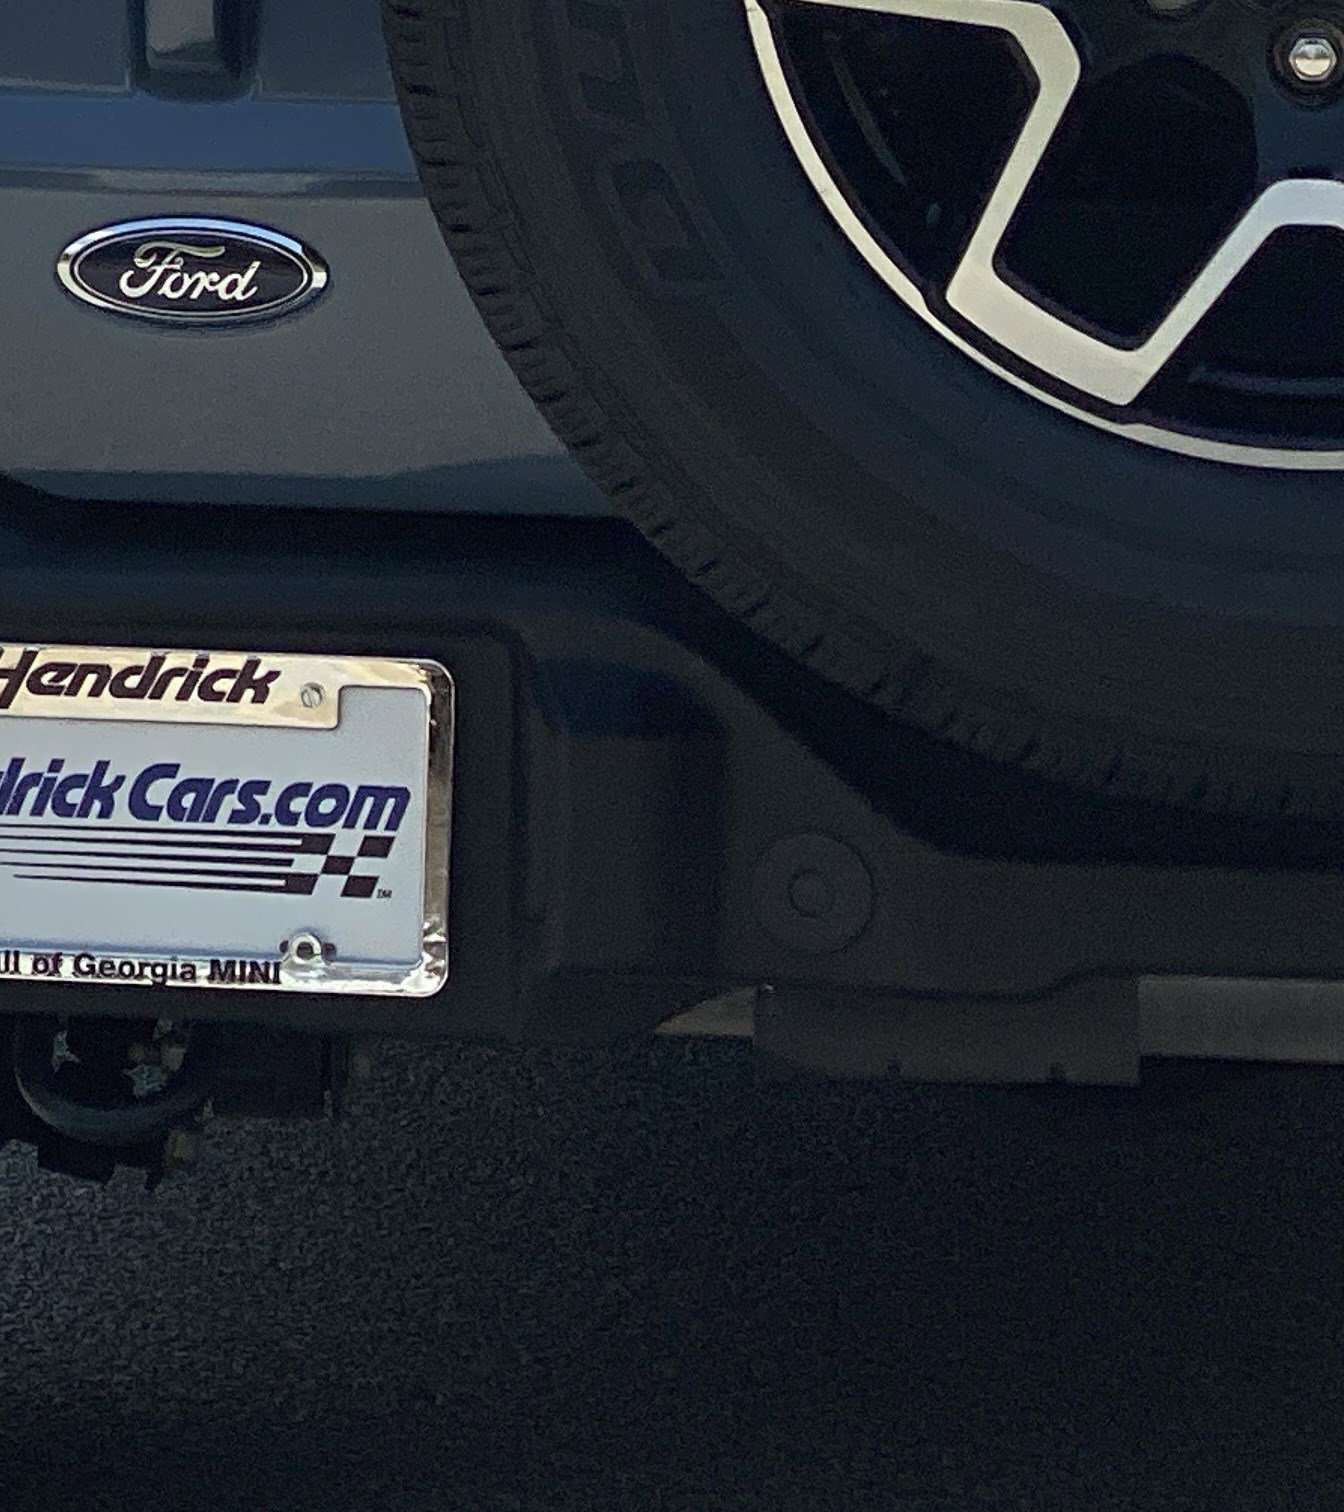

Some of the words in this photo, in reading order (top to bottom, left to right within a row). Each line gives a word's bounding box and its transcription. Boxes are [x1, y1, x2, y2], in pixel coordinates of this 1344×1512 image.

[119, 241, 261, 301] Ford
[30, 951, 64, 974] of
[72, 952, 198, 987] Georgia
[208, 958, 282, 984] MINI
